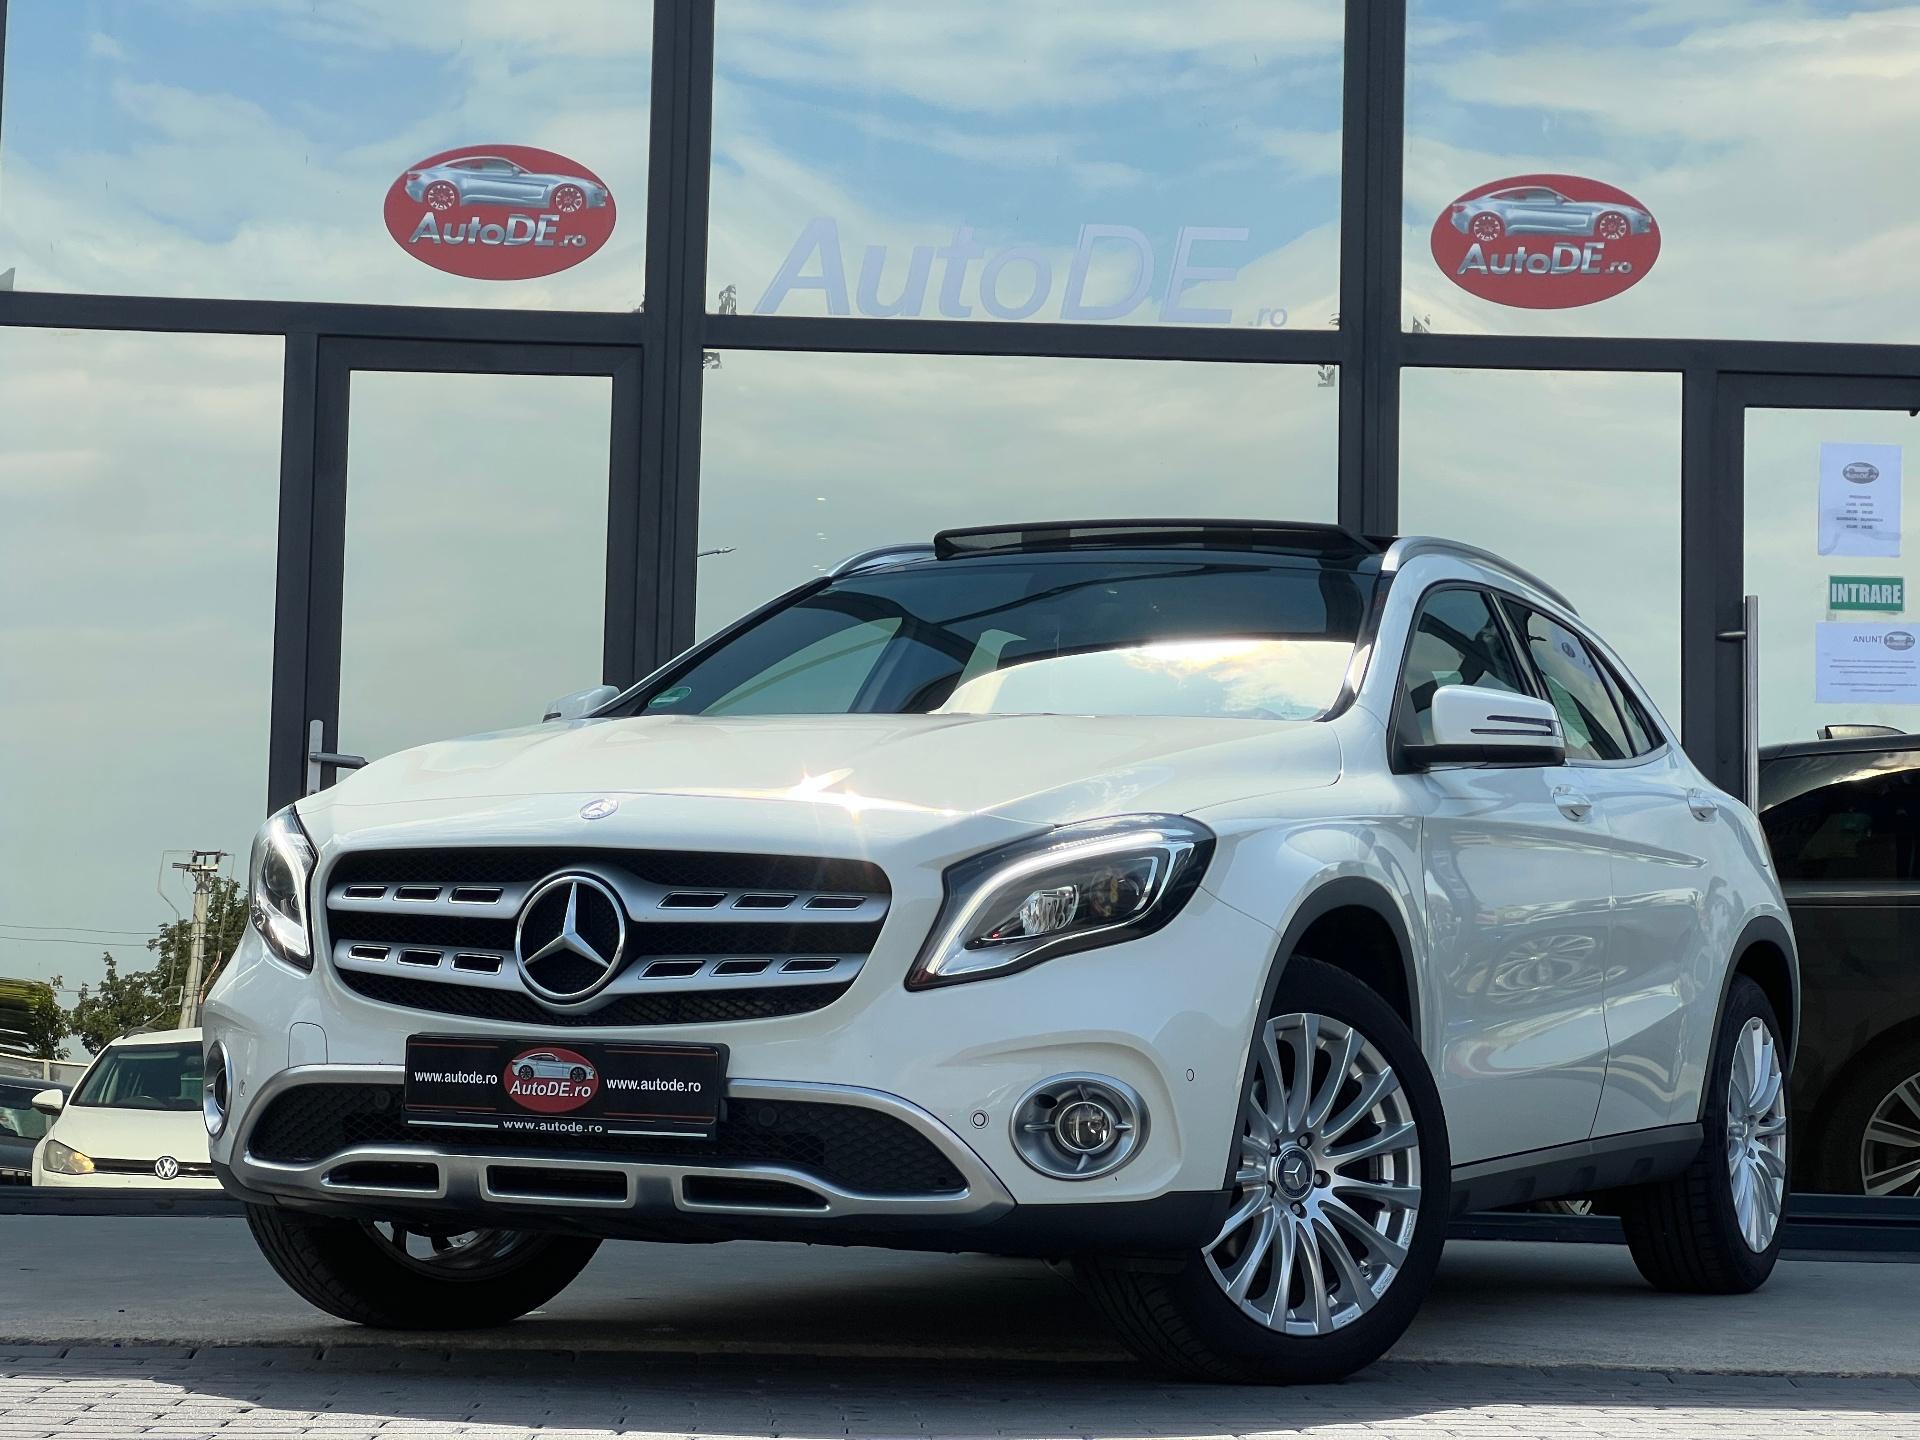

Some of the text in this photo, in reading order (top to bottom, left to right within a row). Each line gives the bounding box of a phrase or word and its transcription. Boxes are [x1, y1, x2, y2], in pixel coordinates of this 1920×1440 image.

[1831, 583, 1902, 604] INTRARE
[414, 1069, 498, 1086] www.autode.ro
[606, 1077, 702, 1093] www.autode.ro
[509, 1079, 592, 1099] AutoDE.ro
[503, 1120, 603, 1133] www.autode.ro
